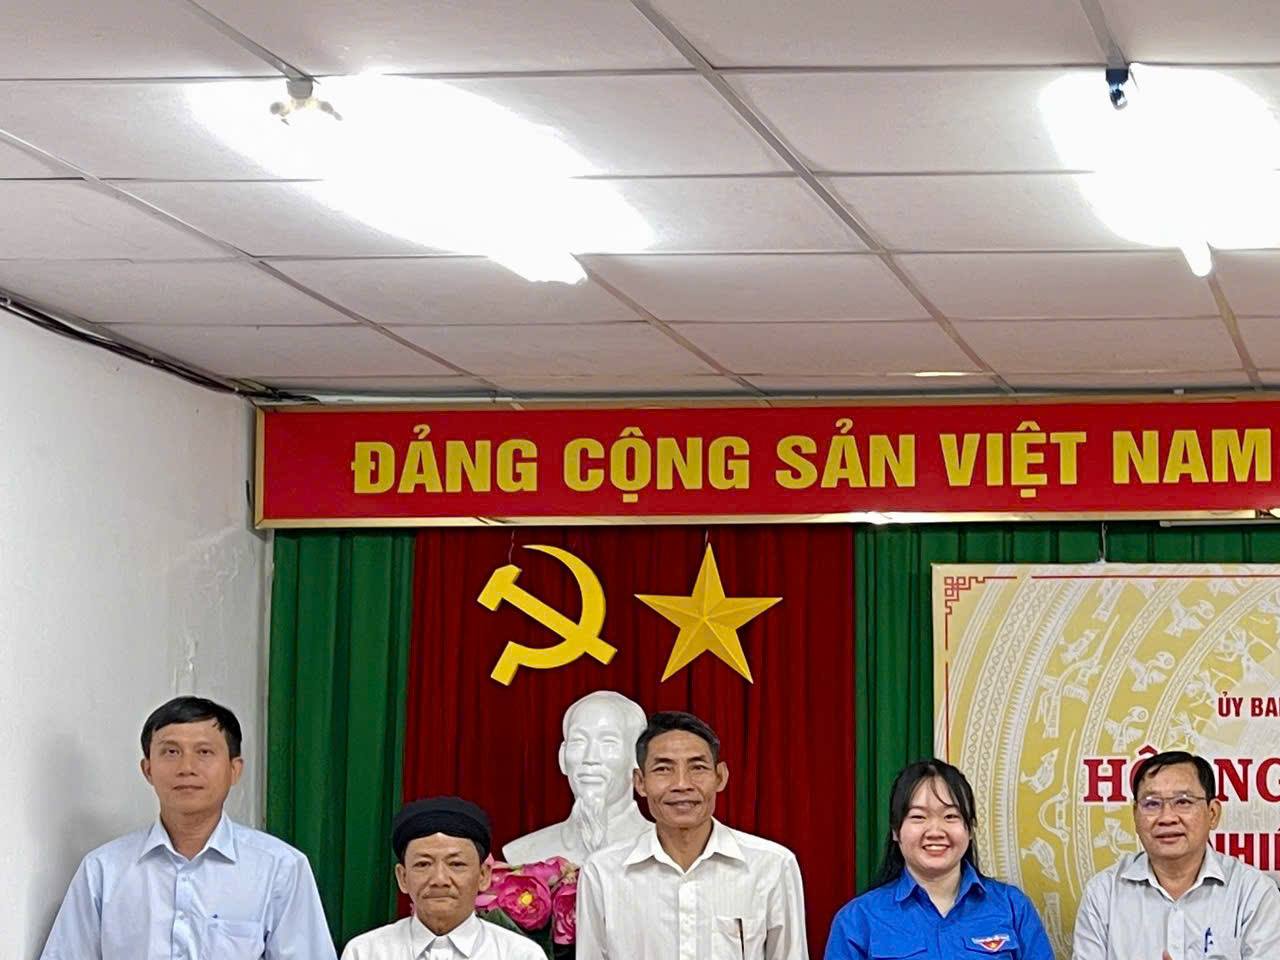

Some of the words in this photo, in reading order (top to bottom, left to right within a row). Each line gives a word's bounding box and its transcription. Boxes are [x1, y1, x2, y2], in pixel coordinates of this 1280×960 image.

[351, 423, 538, 494] ĐẢNG
[563, 427, 750, 503] CỘNG
[775, 418, 916, 489] SẢN
[939, 420, 1087, 498] VIỆT
[1112, 428, 1271, 485] NAM
[1218, 691, 1243, 717] ỦY
